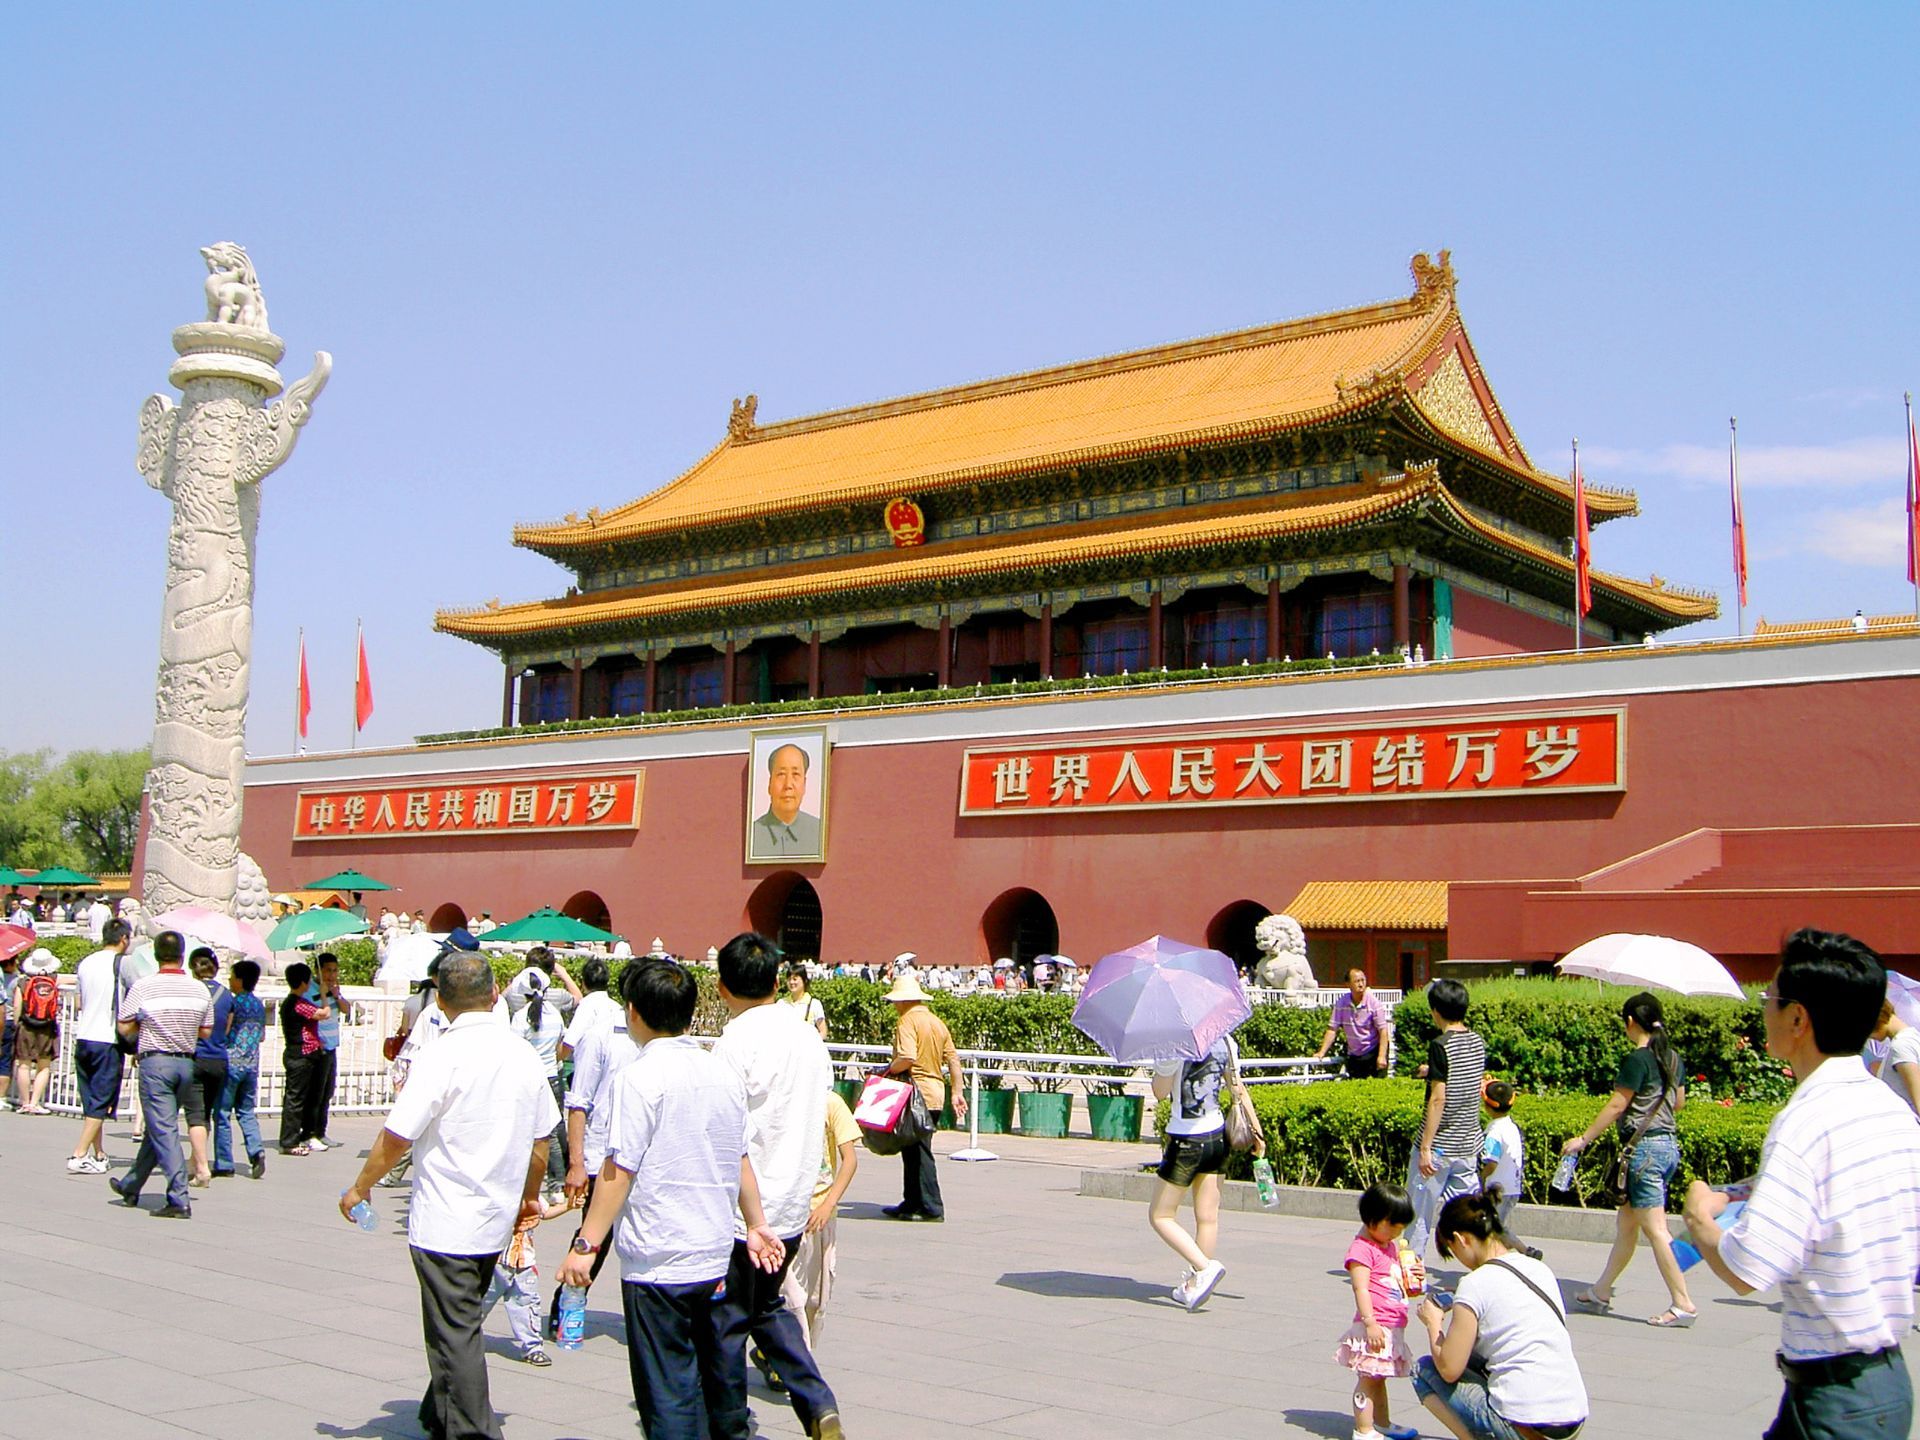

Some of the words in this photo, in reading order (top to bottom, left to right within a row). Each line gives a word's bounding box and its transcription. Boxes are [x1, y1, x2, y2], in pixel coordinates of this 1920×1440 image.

[991, 725, 1582, 804] 世界人民大团结万岁
[309, 781, 618, 832] 中华人民共和国万岁
